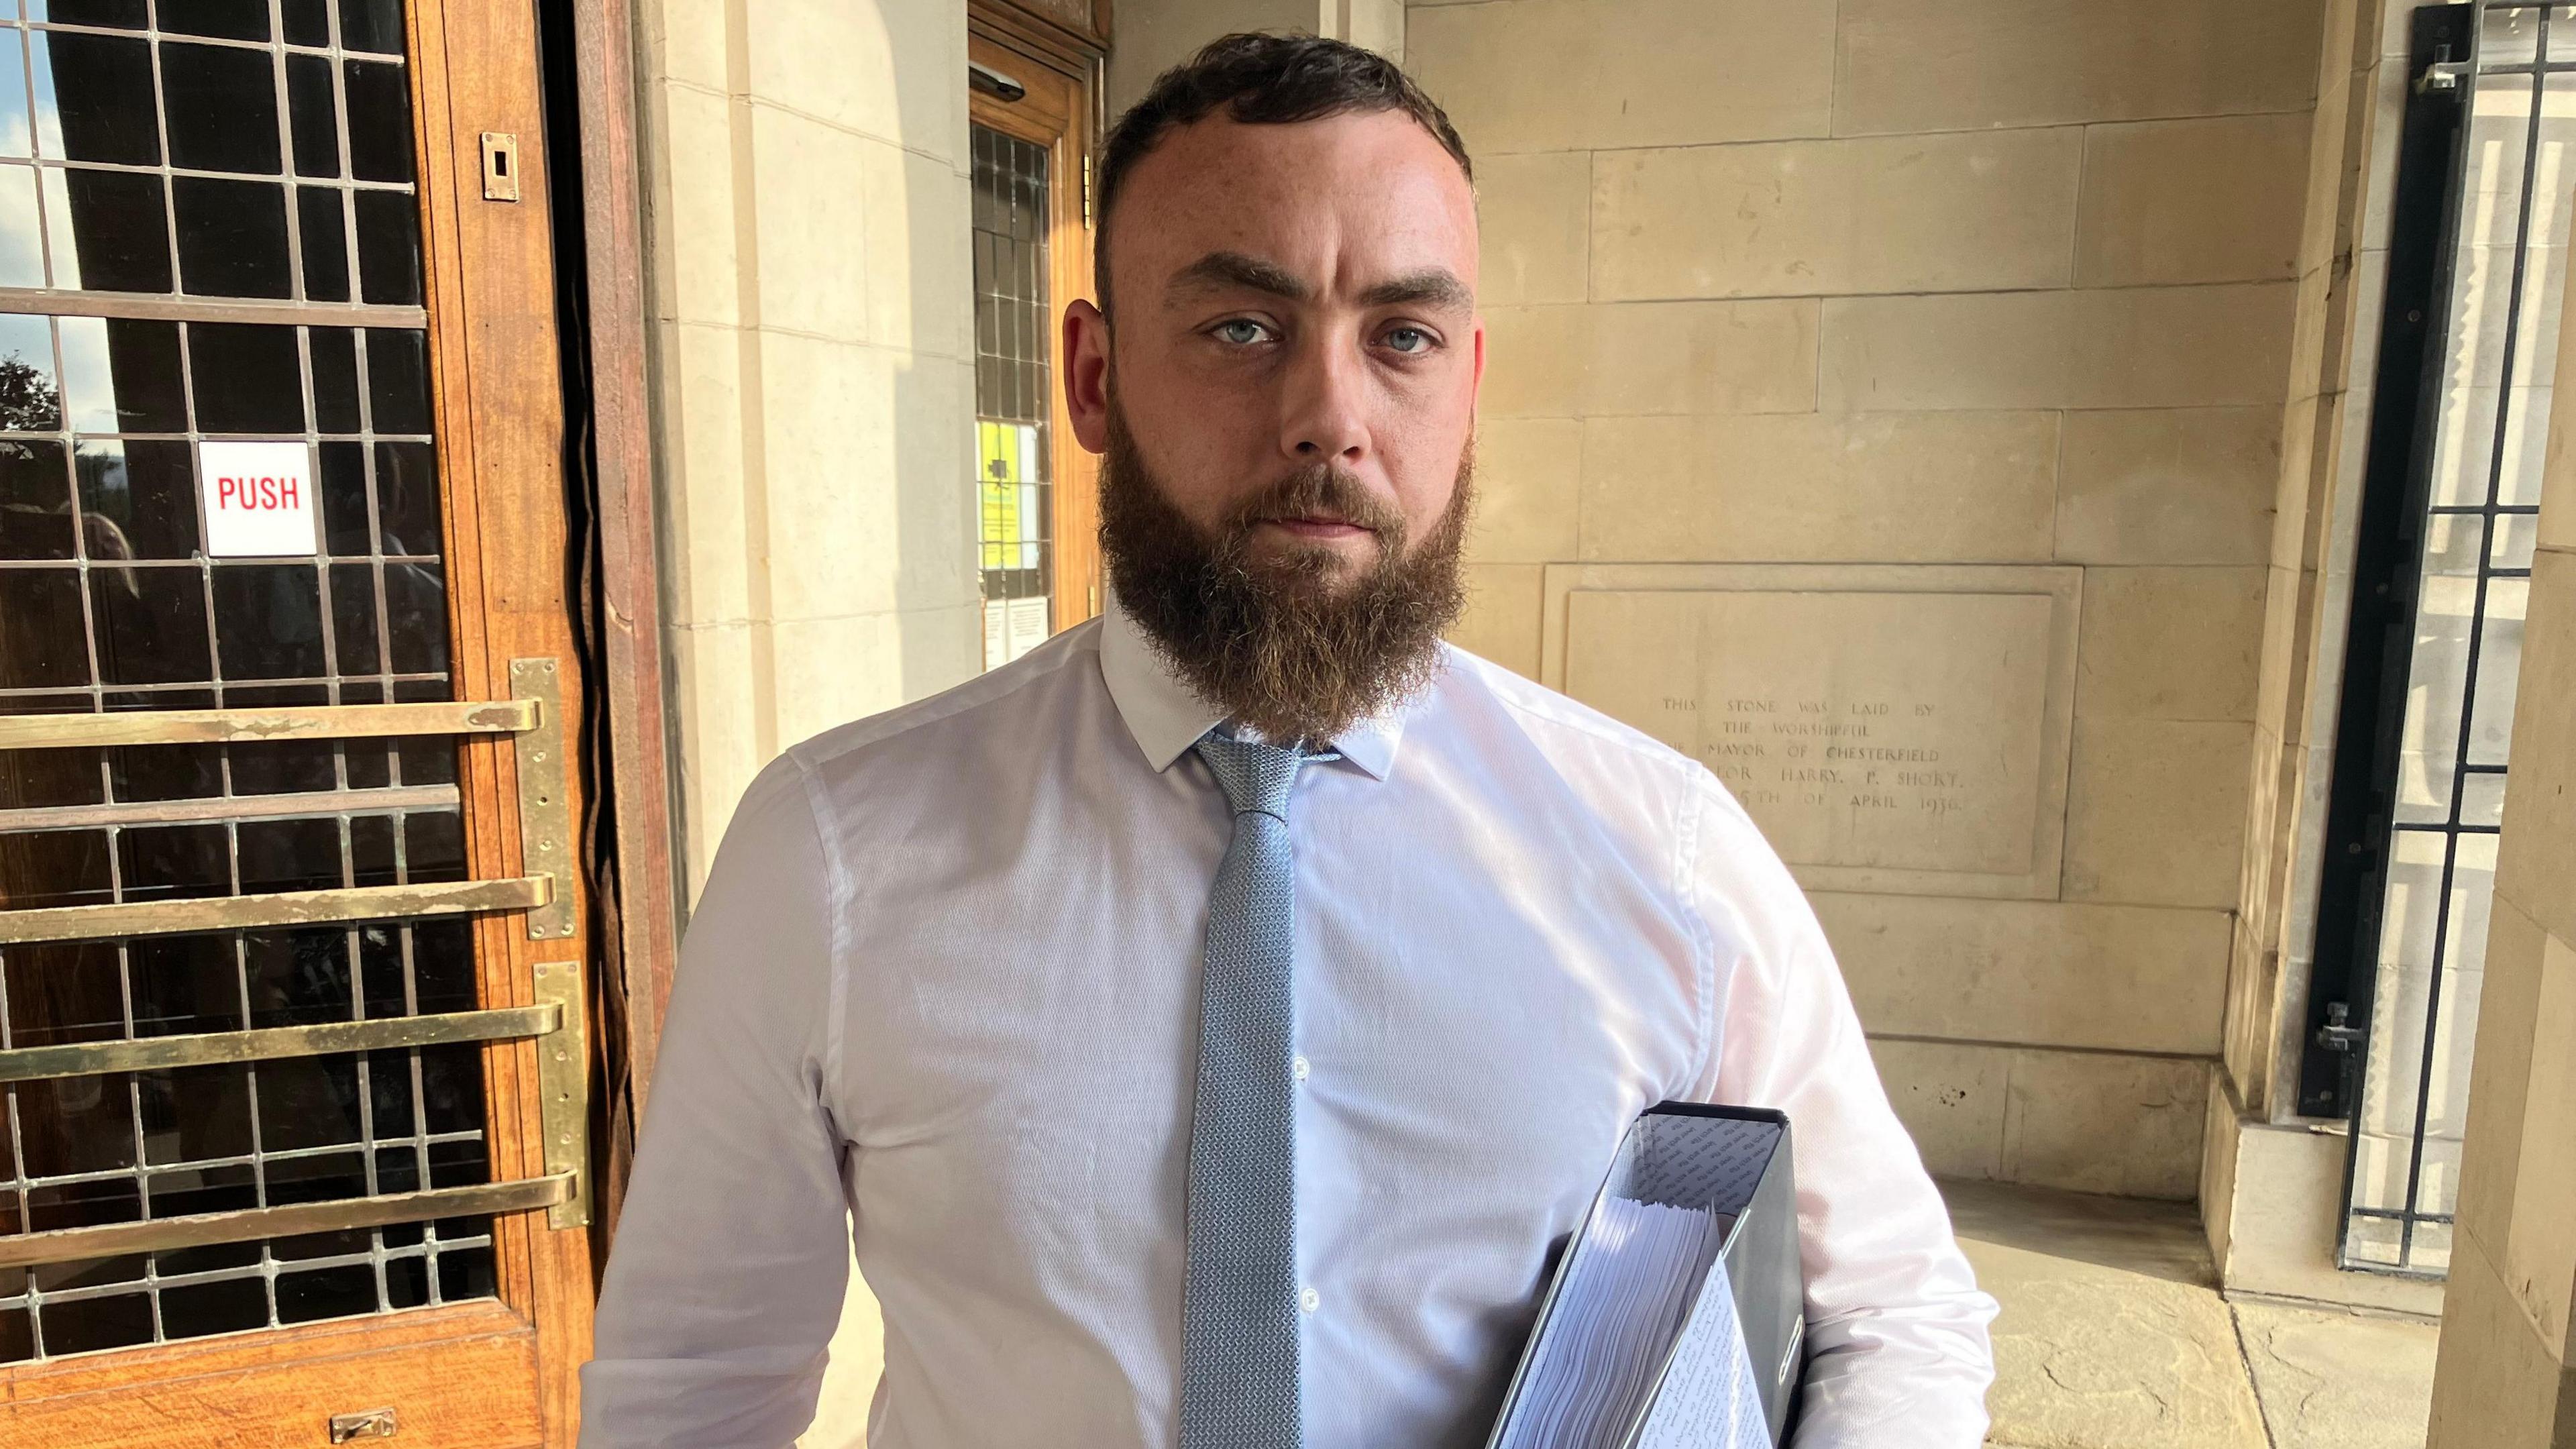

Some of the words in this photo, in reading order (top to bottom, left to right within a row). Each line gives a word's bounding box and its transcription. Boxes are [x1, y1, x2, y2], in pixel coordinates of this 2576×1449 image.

[218, 476, 299, 510] PUSH
[1663, 698, 1697, 711] THIS
[1727, 700, 1776, 713] STONE
[1799, 700, 1828, 714] WAS
[1851, 702, 1889, 716] LAID
[1915, 703, 1935, 717] BY
[1723, 720, 1752, 734] THE
[1772, 722, 1870, 737] WORSHIPFUL
[1707, 743, 1766, 757] MAYOR
[1787, 745, 1809, 759] OF
[1826, 746, 1939, 763] CHESTERFIELD
[1804, 792, 1825, 806] OF
[1849, 794, 1898, 809] APRIL
